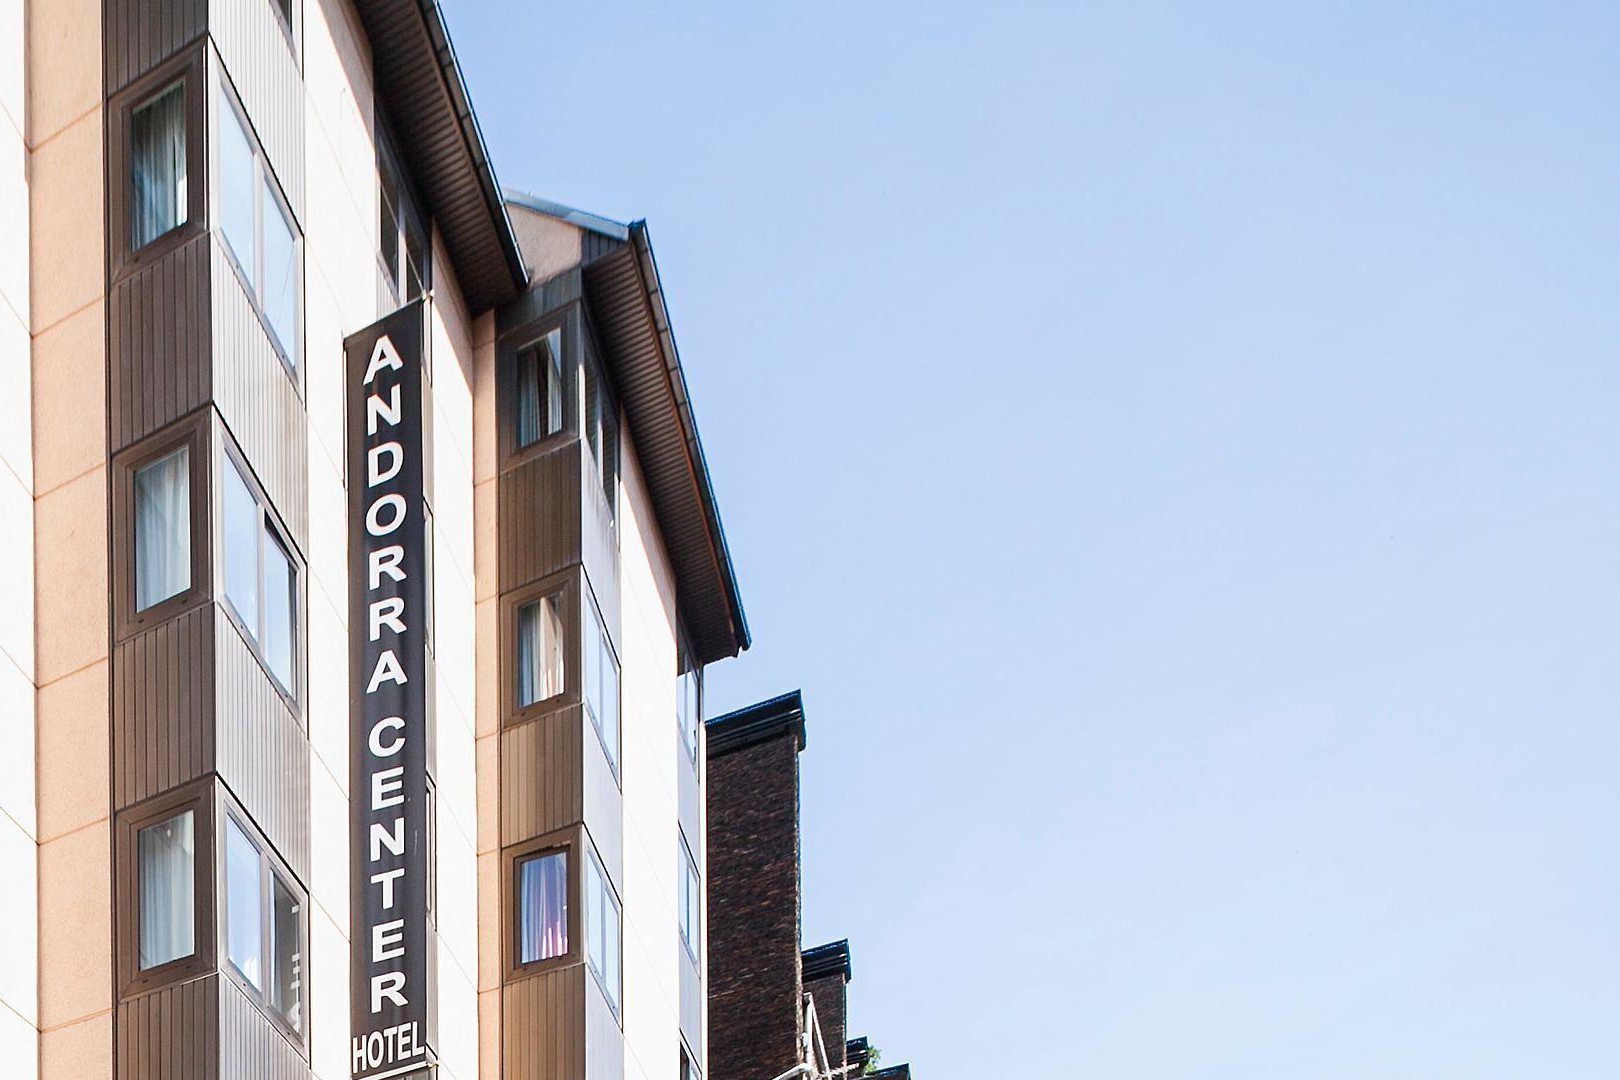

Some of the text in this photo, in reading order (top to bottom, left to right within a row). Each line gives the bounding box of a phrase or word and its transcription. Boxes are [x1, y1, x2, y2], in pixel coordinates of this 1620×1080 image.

[363, 334, 408, 1014] ANDORRA CENTER
[351, 1021, 425, 1074] HOTEL
